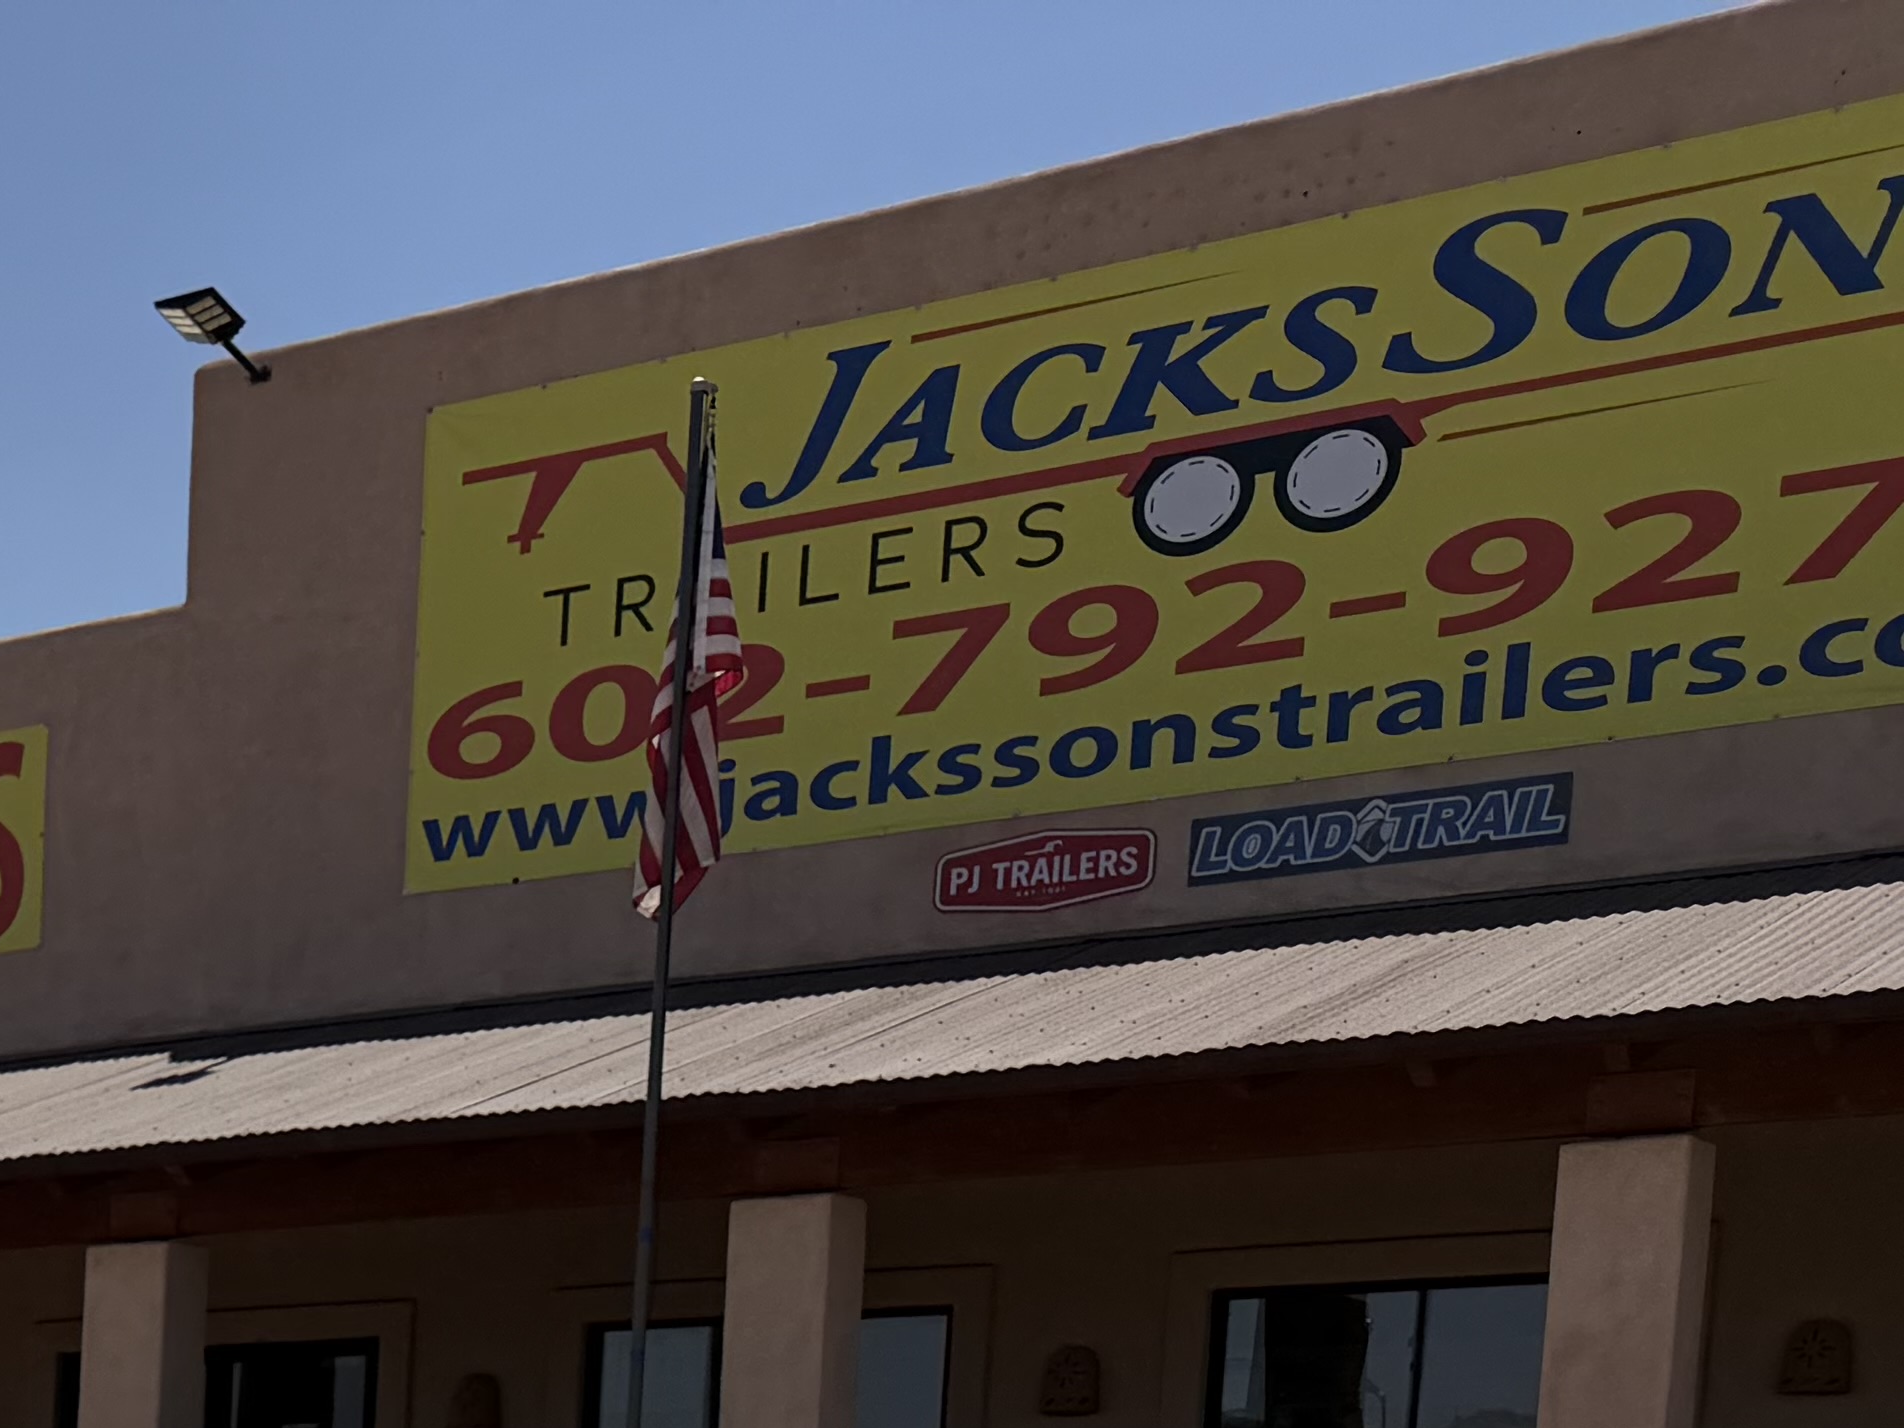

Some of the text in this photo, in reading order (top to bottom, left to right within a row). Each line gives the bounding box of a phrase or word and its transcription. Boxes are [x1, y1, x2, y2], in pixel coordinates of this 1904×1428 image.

[543, 501, 1065, 647] TRILERS
[949, 846, 1138, 896] PJ TRAILERS
[1191, 784, 1567, 877] LOAD TRAIL
